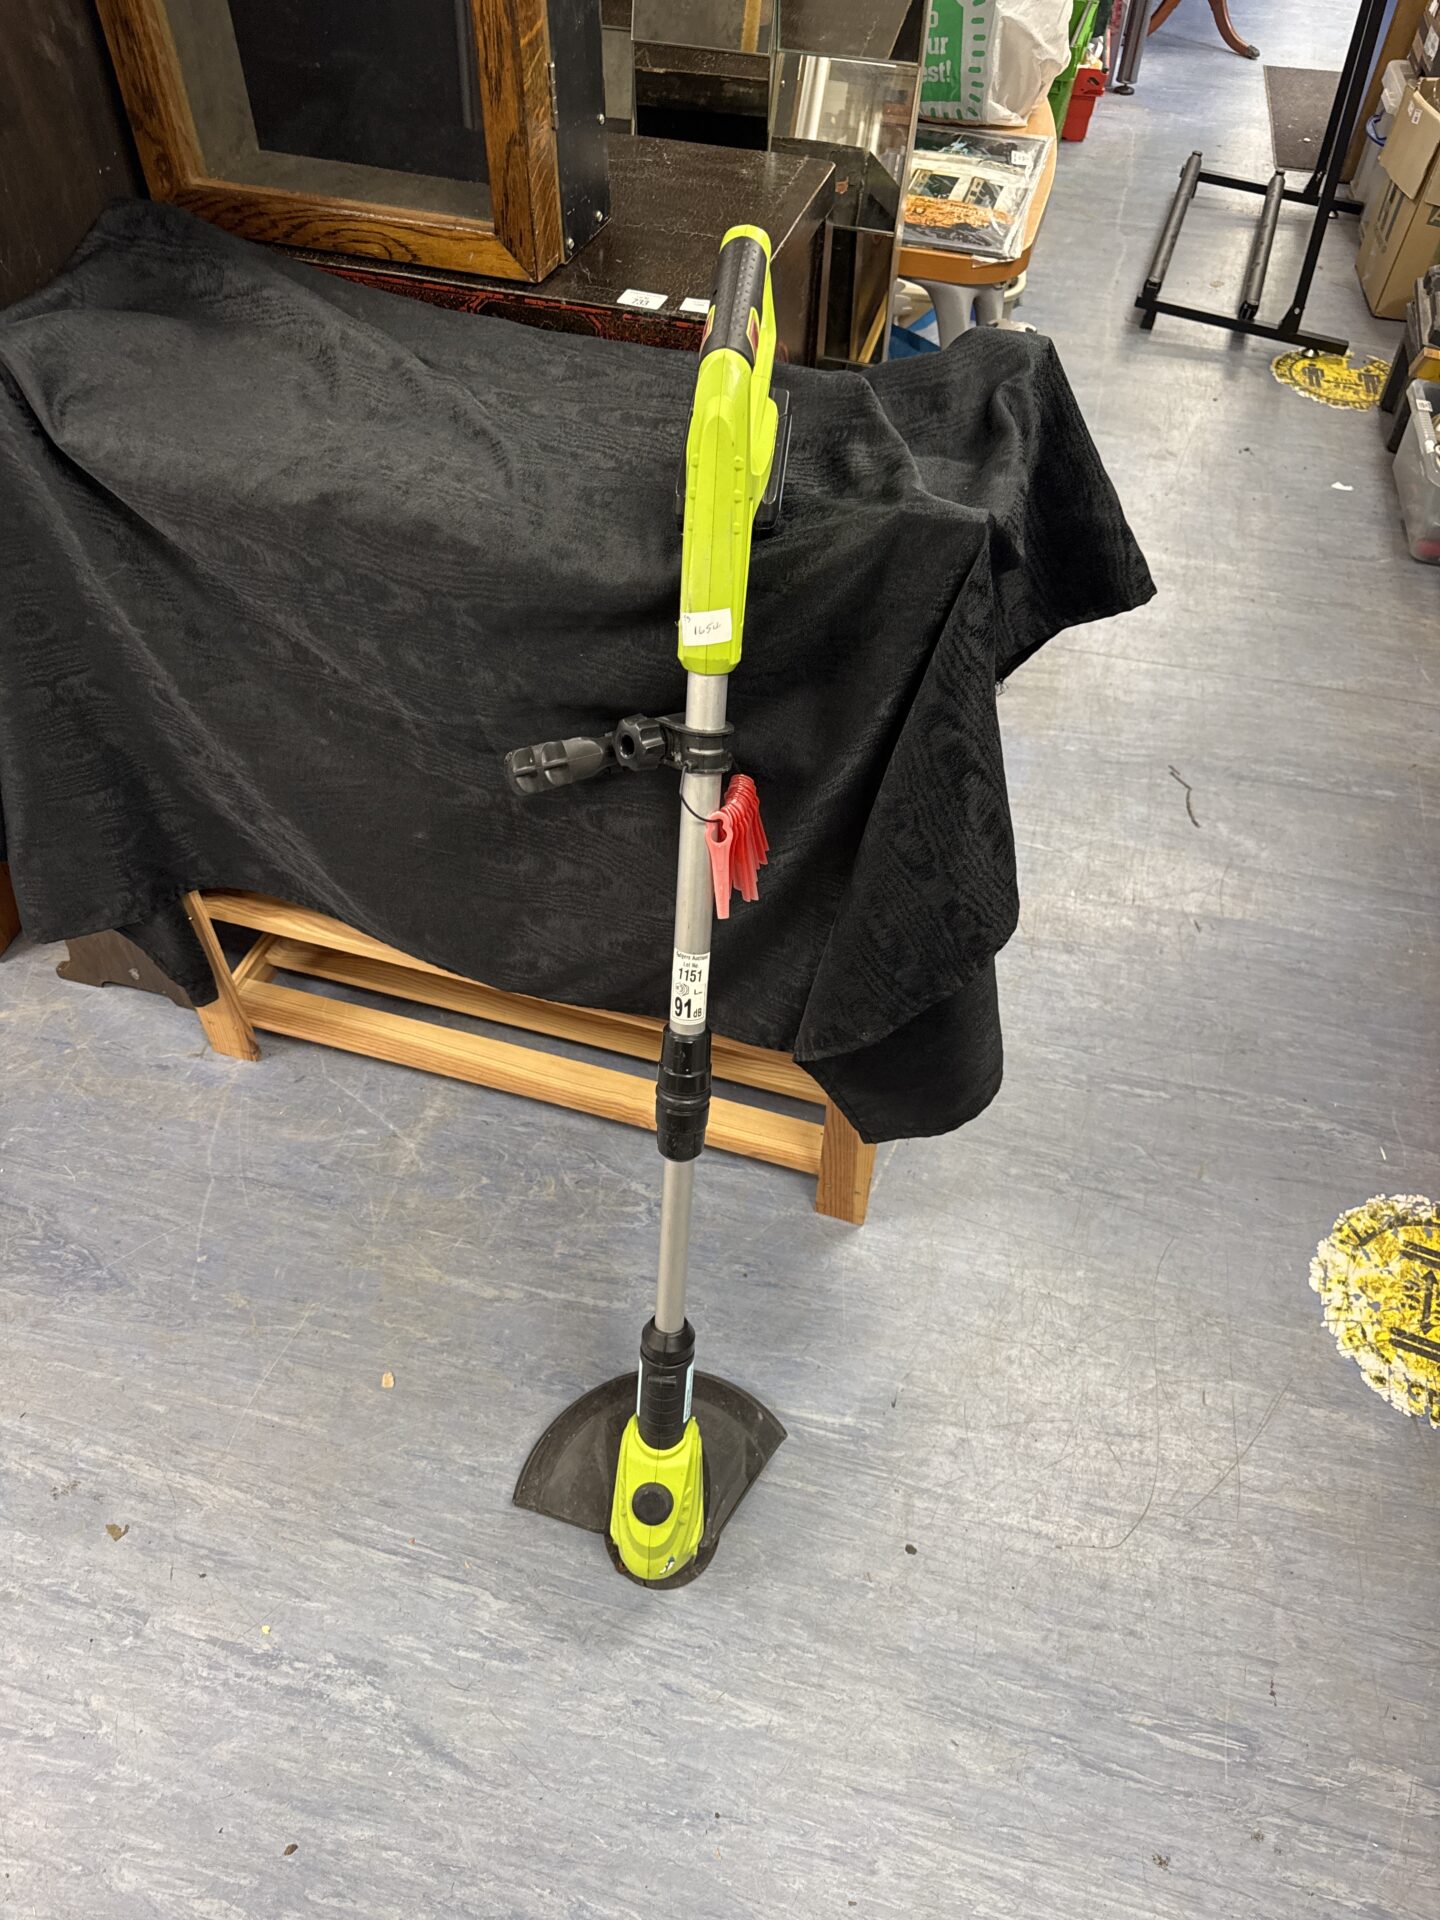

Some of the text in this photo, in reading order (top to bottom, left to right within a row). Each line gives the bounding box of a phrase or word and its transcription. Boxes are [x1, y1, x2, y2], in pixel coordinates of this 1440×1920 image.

[678, 967, 703, 983] 1151
[674, 996, 703, 1019] 91 dB
